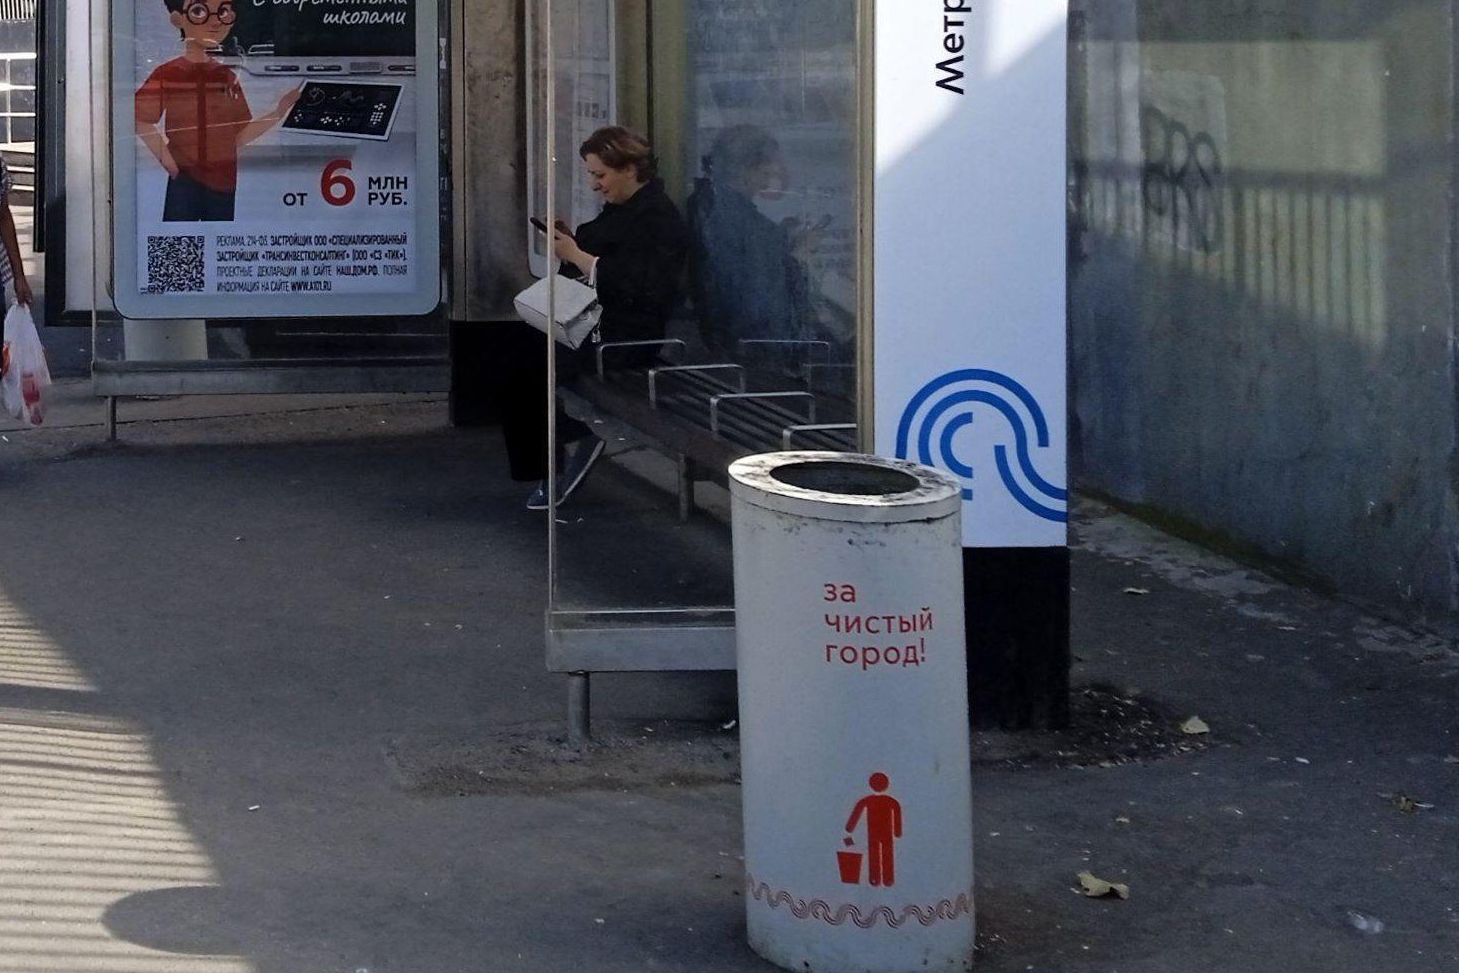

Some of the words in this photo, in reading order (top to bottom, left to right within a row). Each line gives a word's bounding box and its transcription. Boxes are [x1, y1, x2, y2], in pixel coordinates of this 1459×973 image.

[323, 10, 407, 25] школами
[282, 192, 308, 206] ОТ
[321, 158, 356, 206] 6
[368, 176, 408, 190] МЛН
[368, 192, 408, 206] РУБ.
[270, 232, 312, 246] ЗАСТРОЙЩИК
[314, 235, 327, 246] ООО
[216, 248, 259, 262] ЗАСТРОЙЩИК
[257, 266, 297, 277] ДЕКЛАРАЦИИ
[301, 266, 309, 276] НА
[313, 263, 332, 276] САЙТЕ
[216, 281, 259, 292] ИНФОРМАЦИЯ
[261, 281, 270, 292] НА
[270, 279, 290, 292] САЙТЕ
[823, 583, 857, 603] за
[825, 607, 933, 634] чистый
[826, 637, 925, 671] город!
